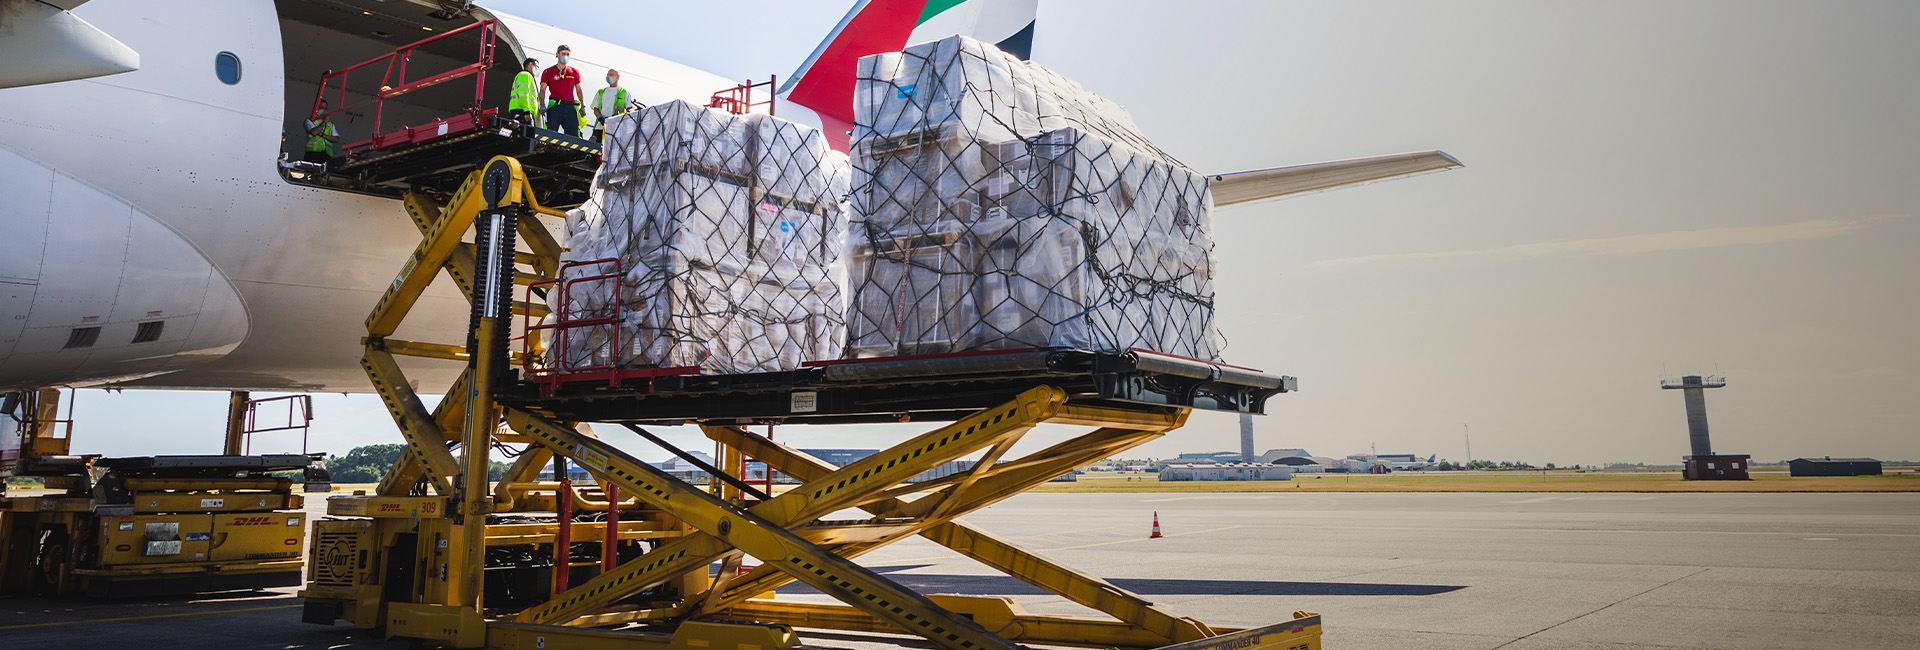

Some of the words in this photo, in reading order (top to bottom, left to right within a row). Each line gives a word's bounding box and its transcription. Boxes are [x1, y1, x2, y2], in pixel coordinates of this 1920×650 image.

[380, 503, 402, 512] DHL
[421, 502, 436, 513] 309
[232, 517, 272, 526] DHL
[1216, 638, 1251, 650] COMMANDER
